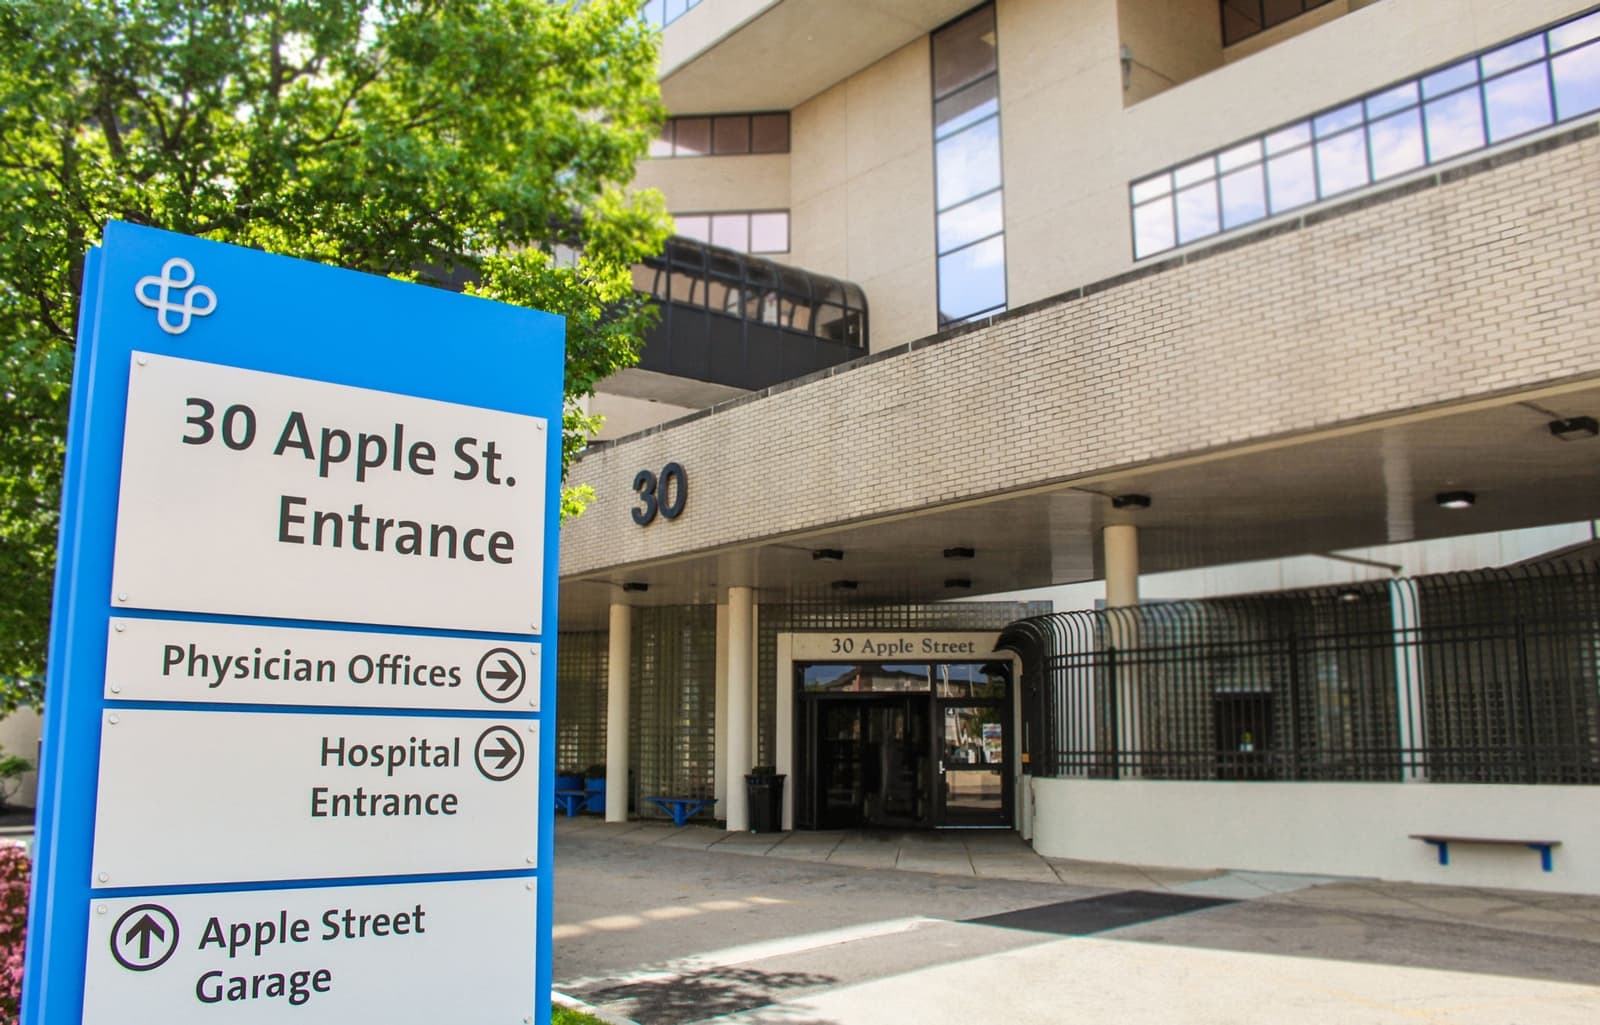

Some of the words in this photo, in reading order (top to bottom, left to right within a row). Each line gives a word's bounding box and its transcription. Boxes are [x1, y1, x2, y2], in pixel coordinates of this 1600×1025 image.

[183, 397, 257, 451] 30
[273, 411, 436, 482] Apple
[453, 436, 516, 487] St.
[632, 462, 688, 526] 30
[278, 495, 514, 564] Entrance
[162, 644, 336, 688] Physician
[348, 654, 462, 688] Offices
[832, 637, 854, 654] 30
[861, 638, 914, 657] Apple
[921, 638, 976, 654] Street
[320, 737, 460, 777] Hospital
[311, 787, 458, 817] Entrance
[198, 910, 310, 957] Apple
[321, 904, 426, 940] Street
[195, 969, 332, 1005] Garage
